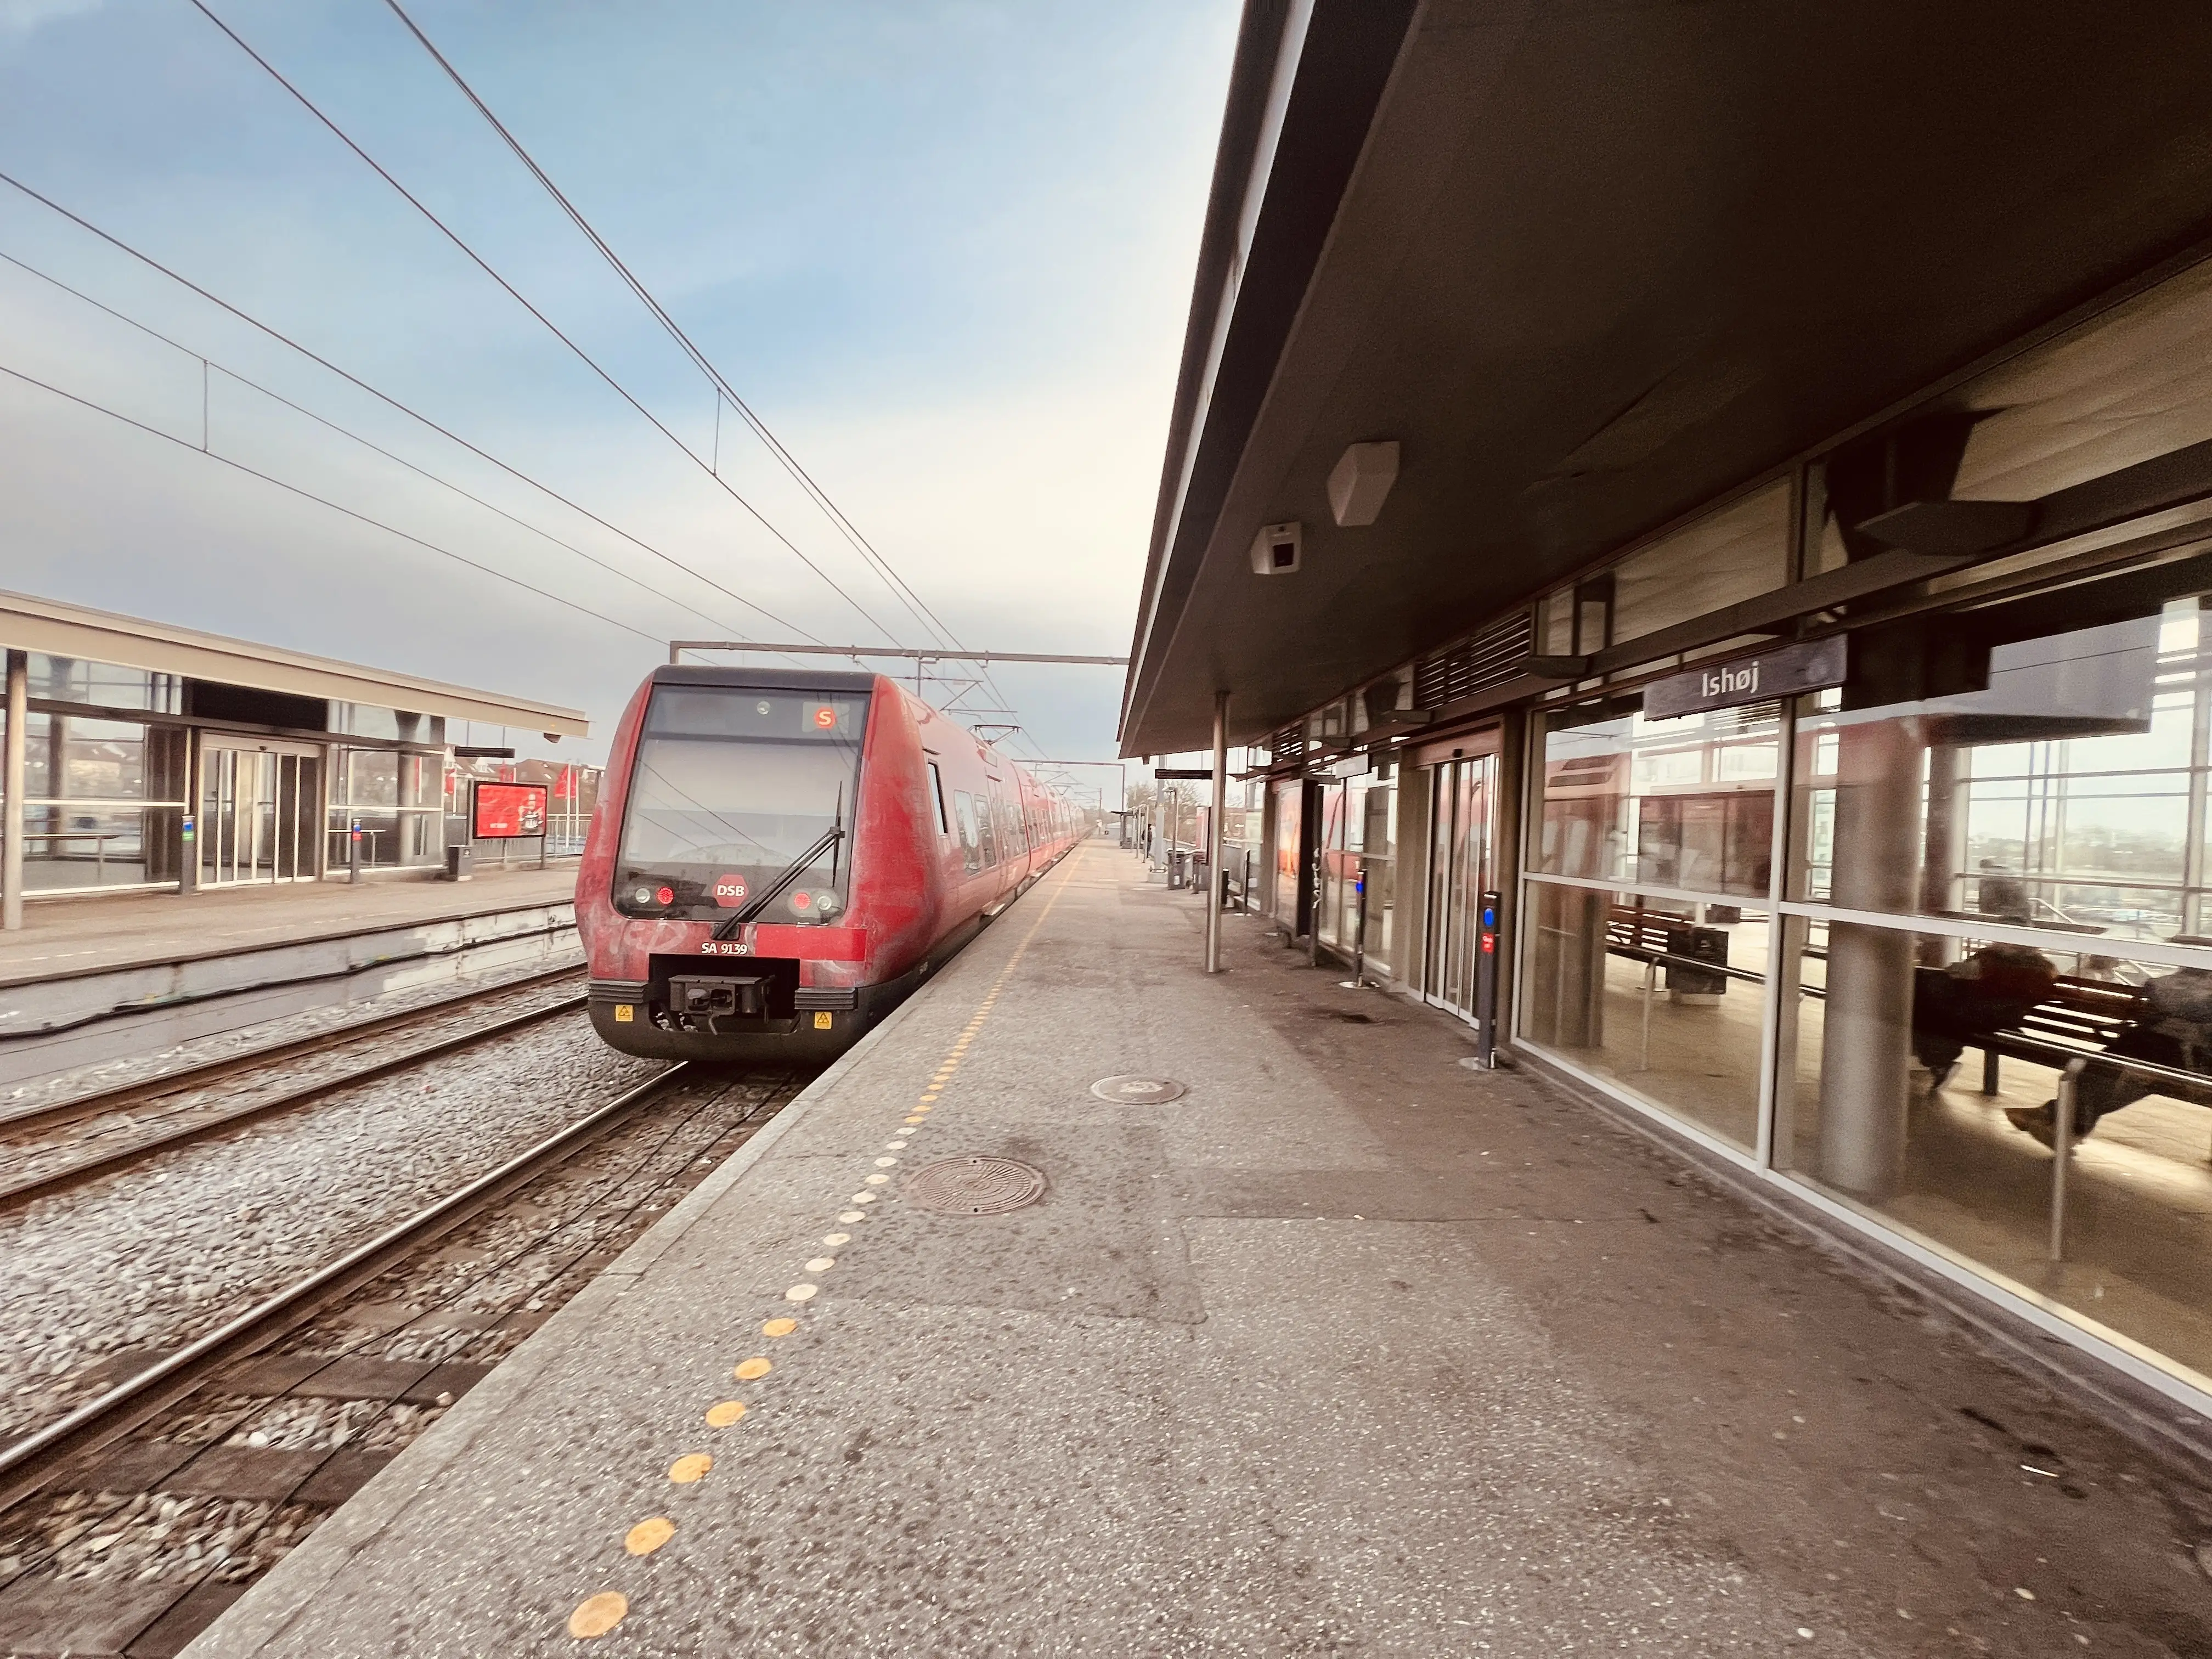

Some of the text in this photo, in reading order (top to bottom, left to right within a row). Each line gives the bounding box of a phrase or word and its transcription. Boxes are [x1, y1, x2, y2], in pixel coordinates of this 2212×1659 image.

[1702, 661, 1759, 697] Ishøj
[819, 711, 831, 725] S
[717, 885, 744, 896] DSB
[701, 943, 748, 955] SA 9139
